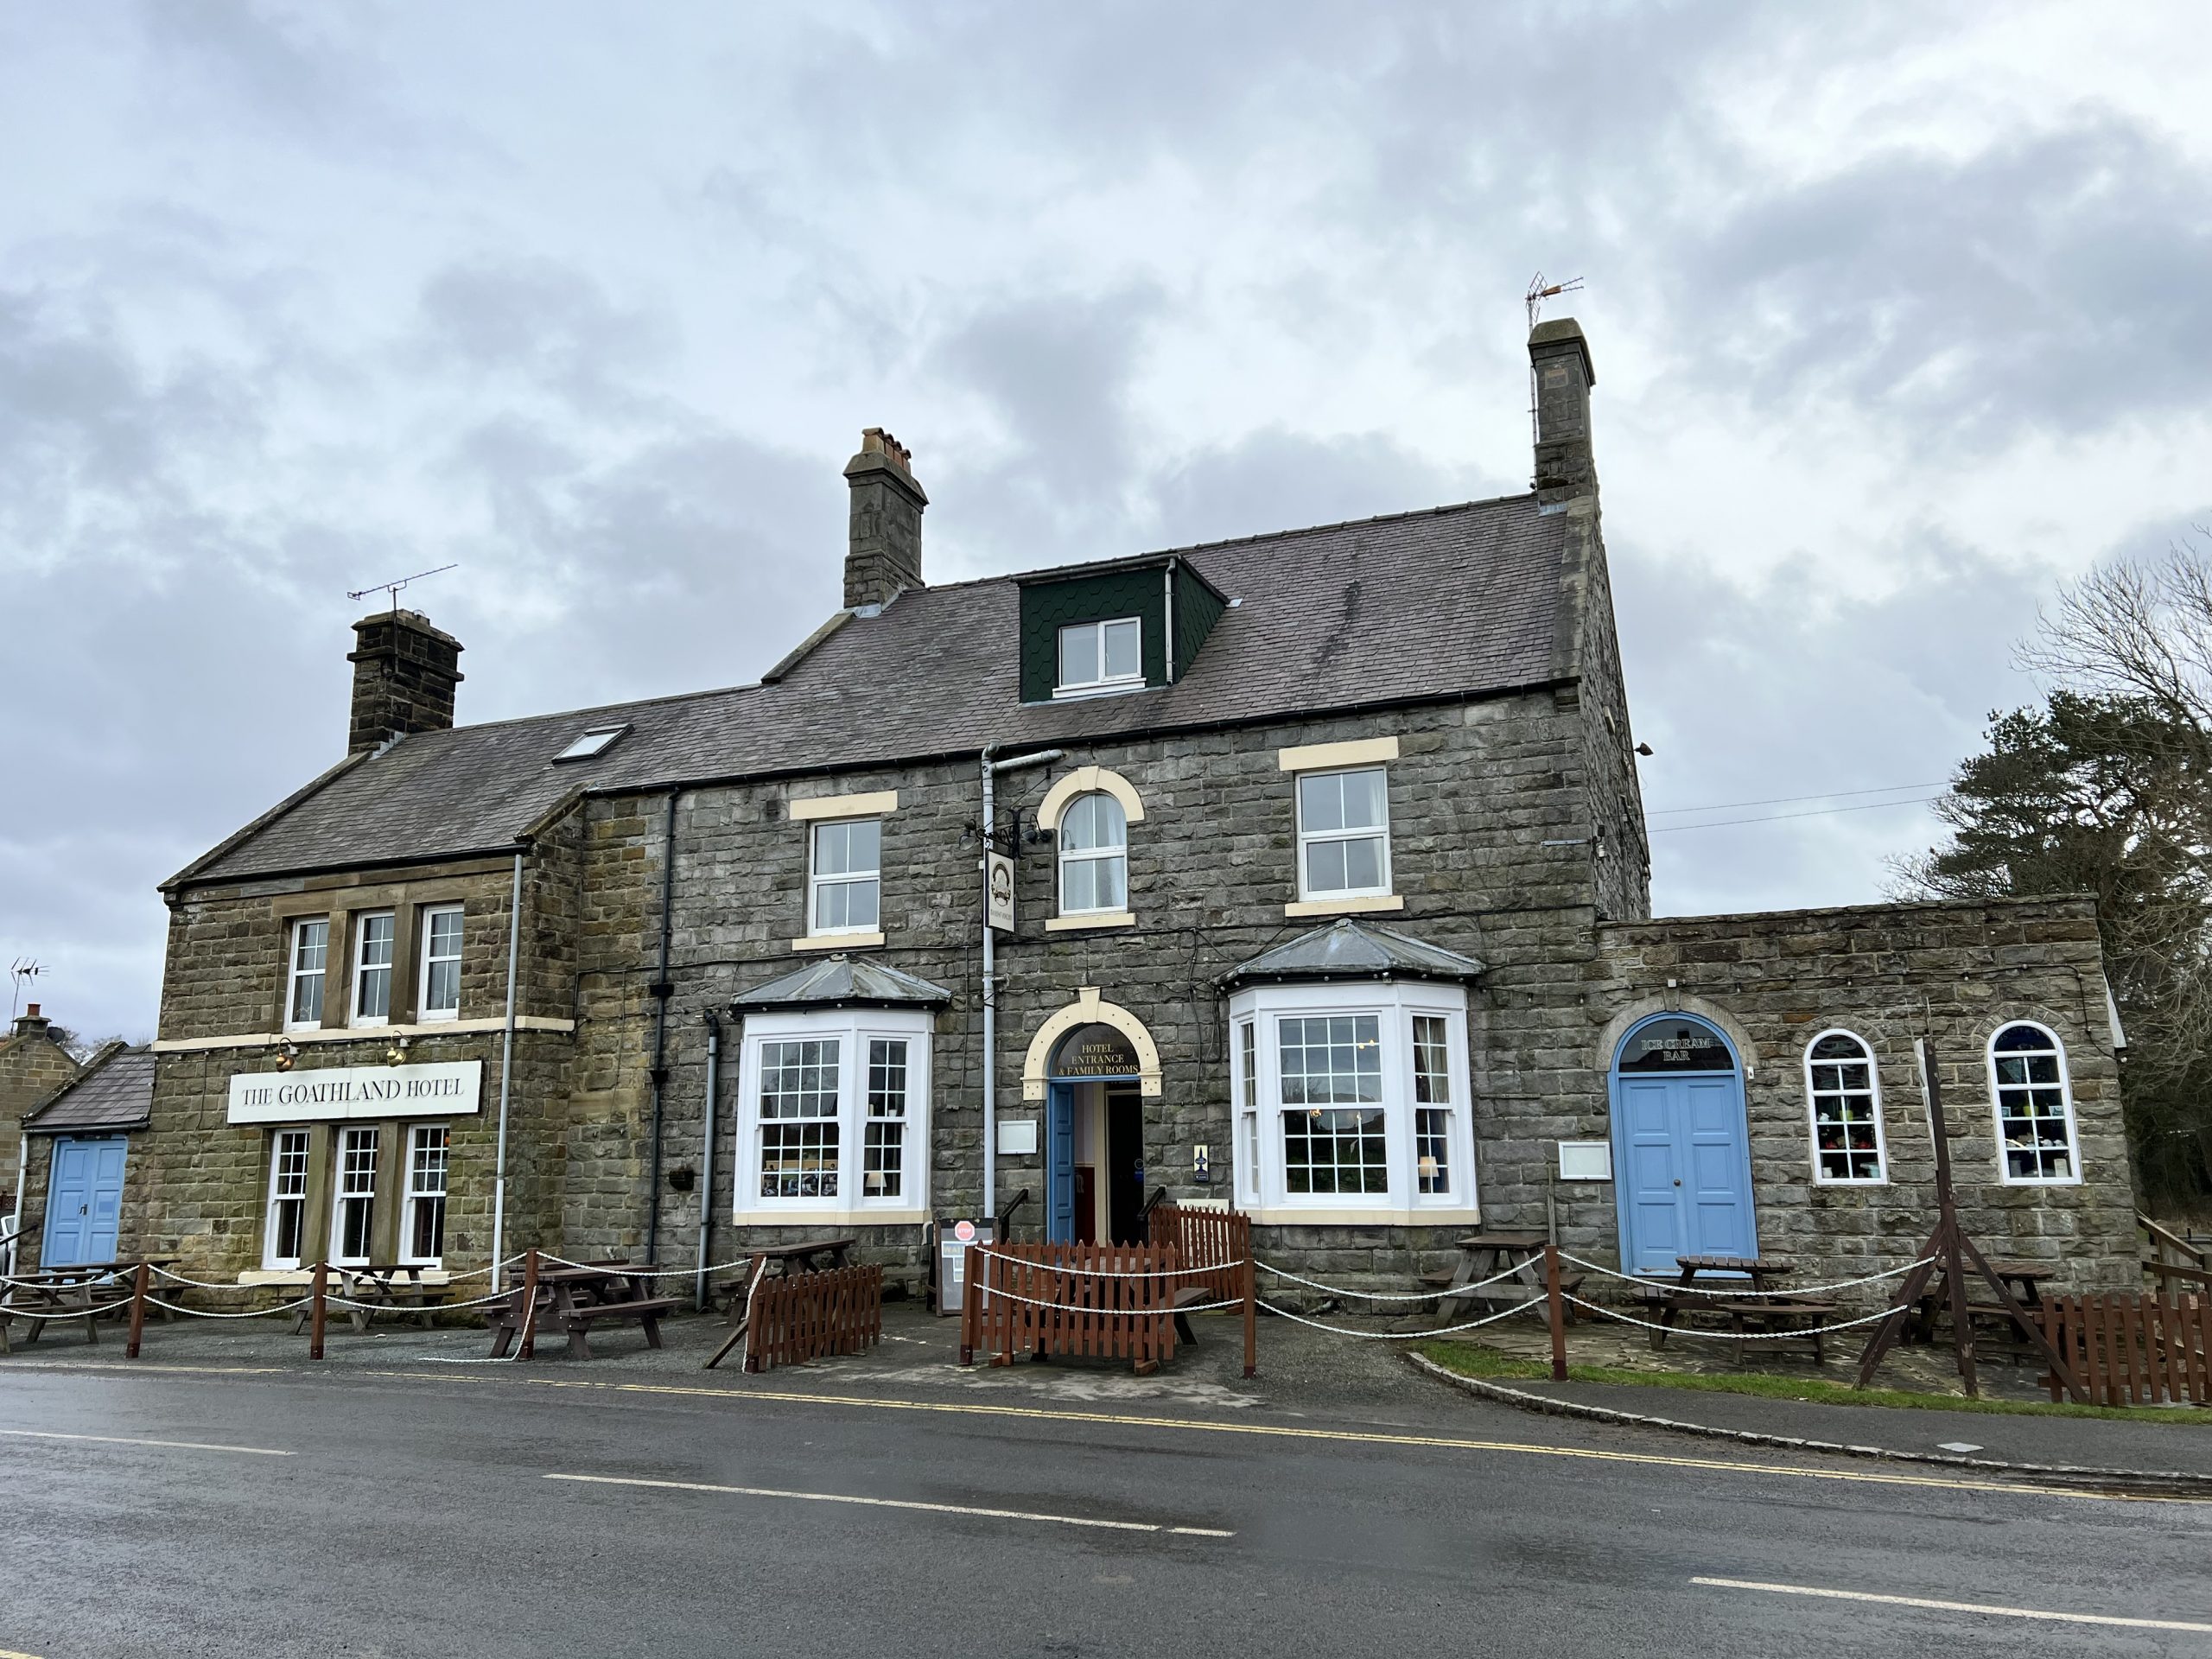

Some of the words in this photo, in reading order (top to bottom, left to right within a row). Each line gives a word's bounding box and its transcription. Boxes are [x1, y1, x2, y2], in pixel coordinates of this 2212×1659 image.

[1082, 1044, 1114, 1053] HOTEL
[1641, 1039, 1663, 1050] ICE
[1664, 1038, 1711, 1049] CREAM
[1071, 1054, 1125, 1065] ENTRANCE
[1663, 1051, 1690, 1061] BAR
[1067, 1066, 1104, 1076] FAMILY
[1105, 1065, 1139, 1075] ROOMS
[241, 1088, 273, 1107] THE
[278, 1079, 402, 1105] GOATHLAND
[407, 1077, 464, 1097] HOTEL
